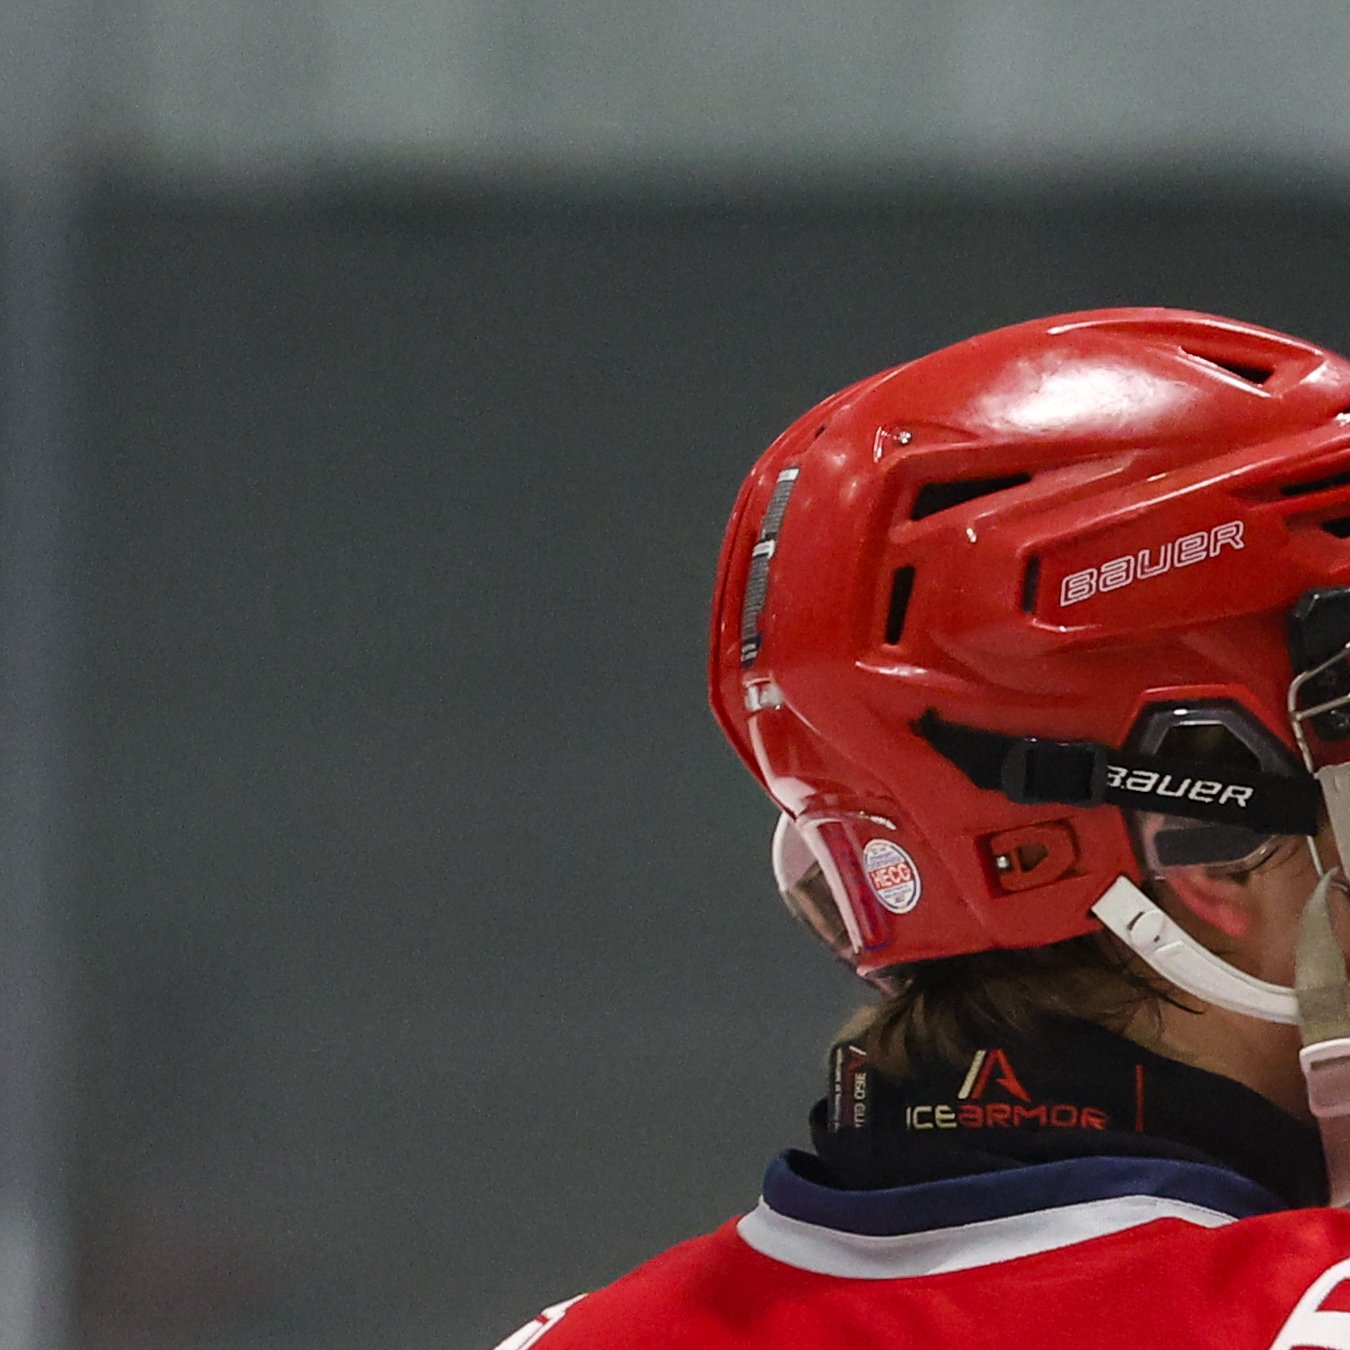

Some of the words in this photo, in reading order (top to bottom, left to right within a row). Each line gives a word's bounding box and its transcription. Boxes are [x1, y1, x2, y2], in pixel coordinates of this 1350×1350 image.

[1059, 520, 1245, 608] BAUER
[1107, 764, 1254, 808] BAUER
[906, 1102, 1108, 1132] ICEARMOR
